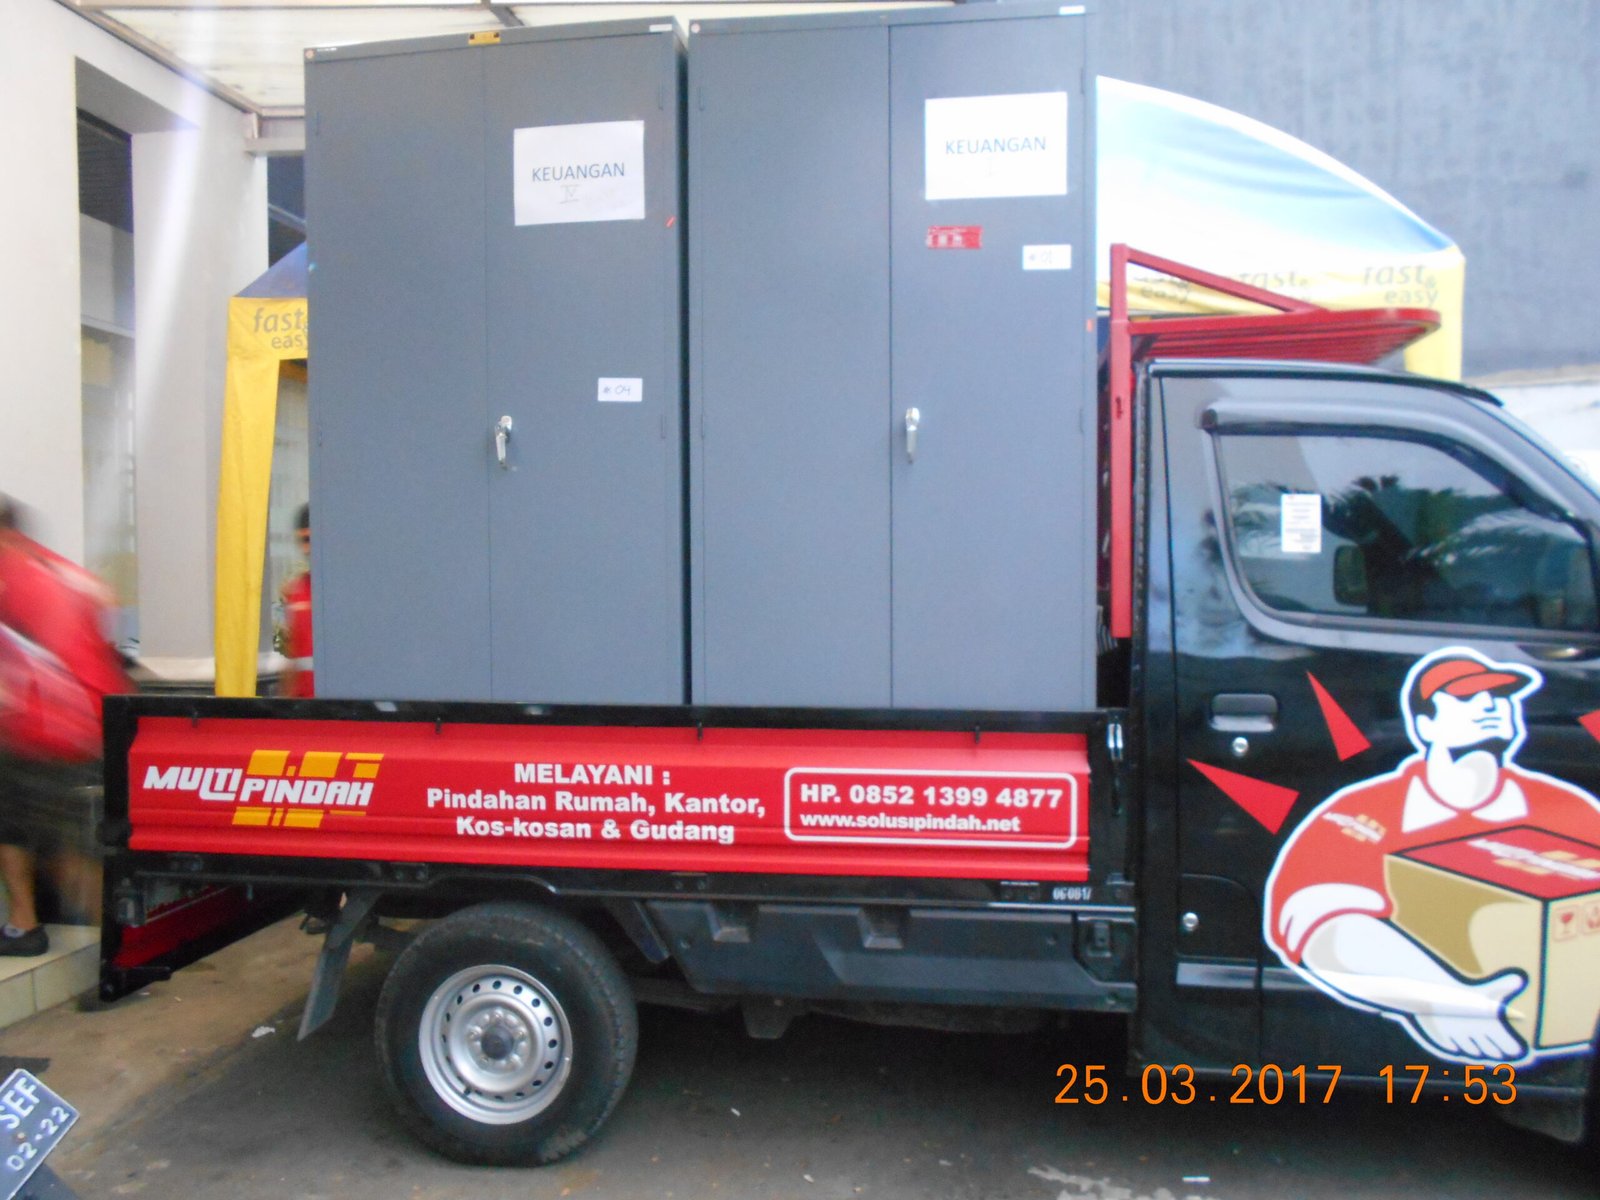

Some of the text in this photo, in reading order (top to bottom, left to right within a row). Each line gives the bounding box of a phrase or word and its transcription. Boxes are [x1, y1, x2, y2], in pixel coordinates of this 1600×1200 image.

[944, 136, 1047, 155] KEUANGAN
[531, 162, 625, 182] KEUANGAN
[1384, 288, 1439, 307] easy
[254, 306, 305, 334] fast
[271, 334, 307, 350] eas
[143, 765, 375, 807] MULTI PINDAH
[514, 763, 671, 786] MELAYANI :
[427, 788, 766, 818] Pindahan Rumah, Kantor,
[800, 783, 1063, 809] HP. 0852 1399 4877
[456, 816, 735, 845] Kos-kosan & Gudang
[799, 812, 1021, 832] www.solusipindah.net
